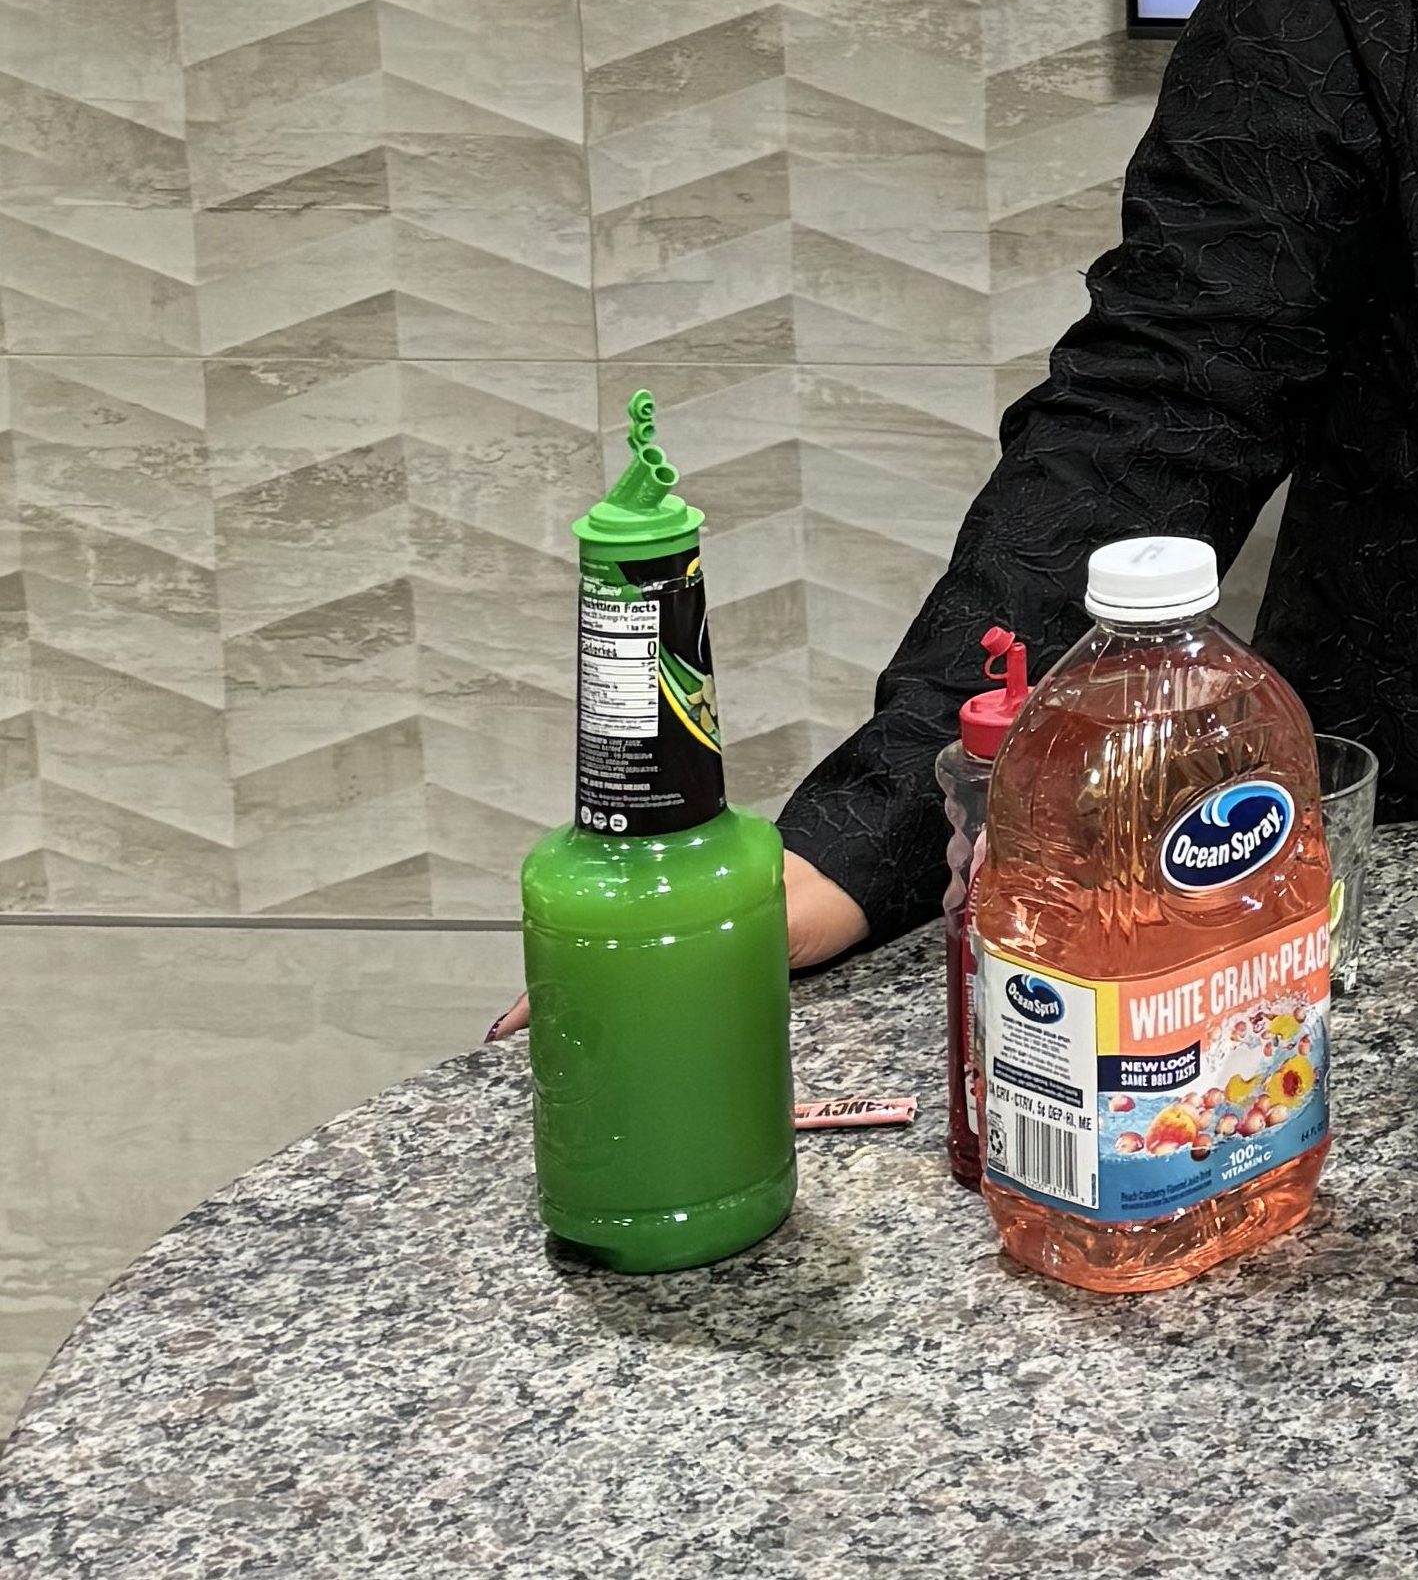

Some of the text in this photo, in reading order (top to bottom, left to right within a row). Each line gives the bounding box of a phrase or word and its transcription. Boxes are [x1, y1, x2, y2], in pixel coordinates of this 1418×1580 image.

[647, 640, 657, 657] 0
[1172, 805, 1281, 869] Ocean Spray
[1008, 982, 1060, 1017] Ocean Spray
[1129, 978, 1206, 1041] WHITE
[1121, 1050, 1196, 1072] NEW LOOK
[1121, 1072, 1148, 1087] SAME
[1079, 1115, 1092, 1131] ME
[1221, 1158, 1264, 1181] VITAMIN
